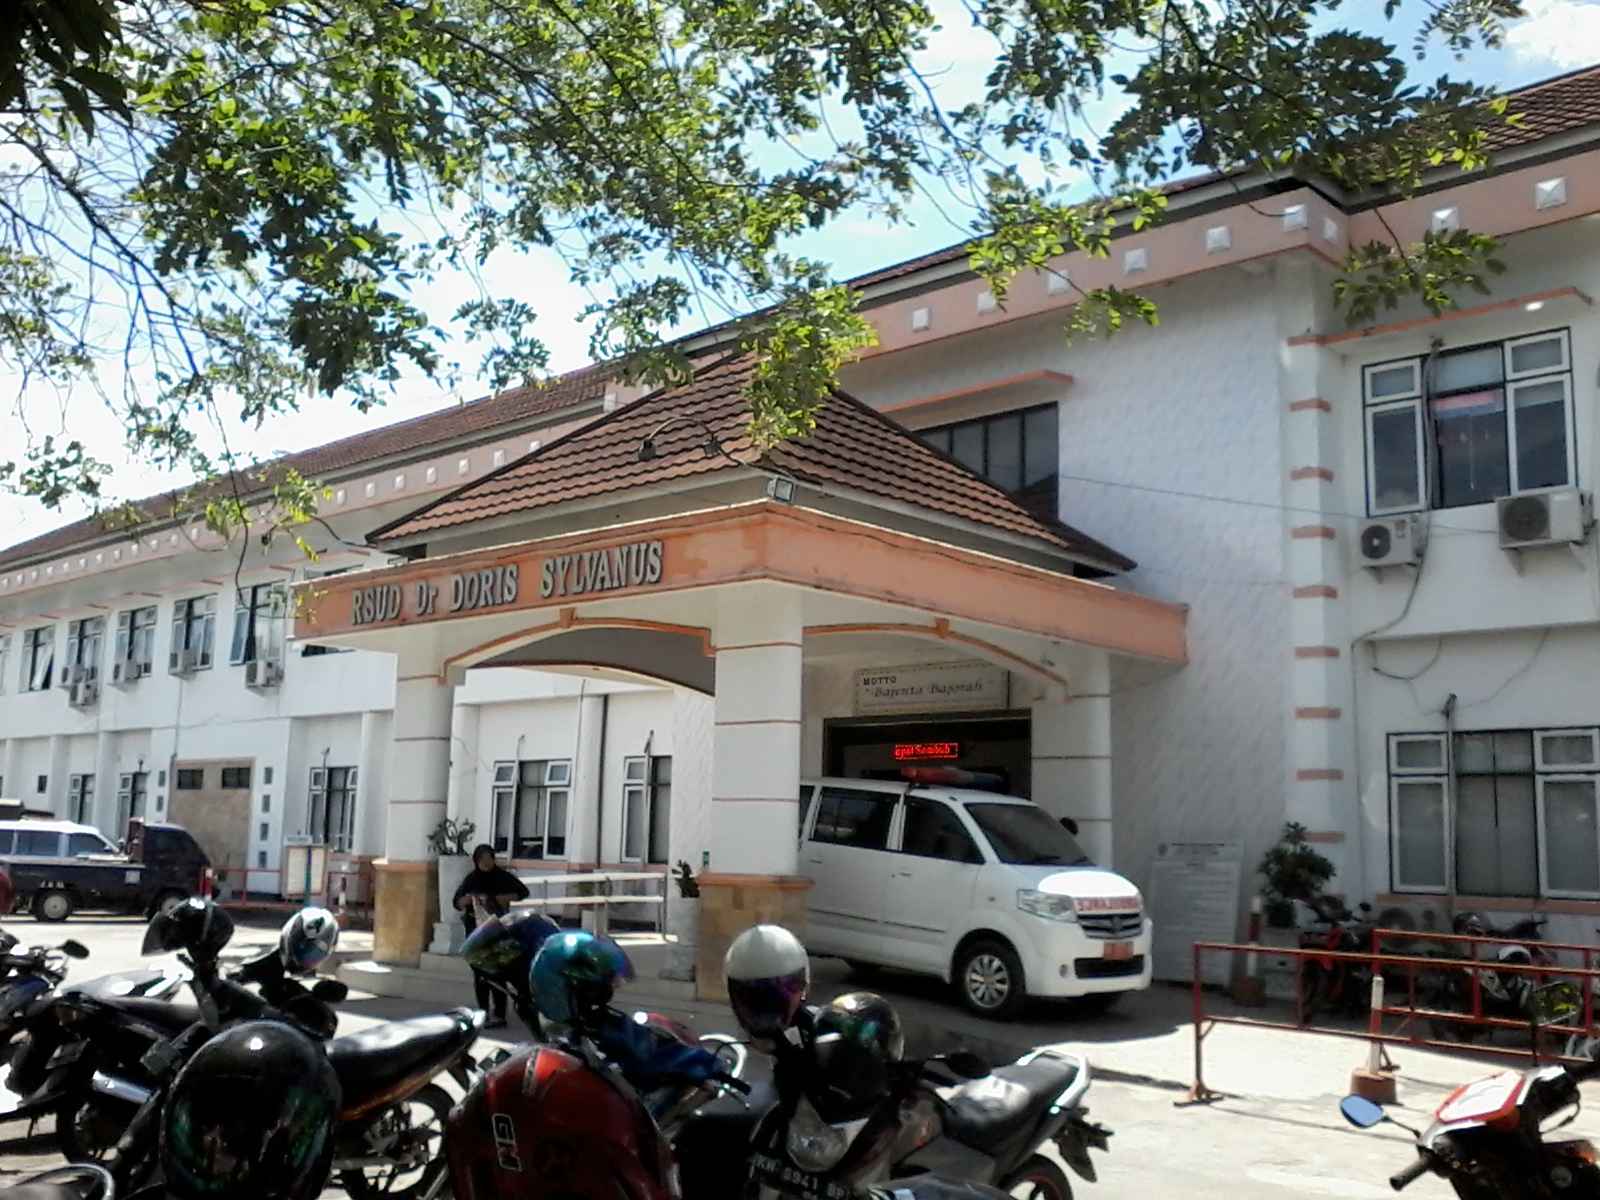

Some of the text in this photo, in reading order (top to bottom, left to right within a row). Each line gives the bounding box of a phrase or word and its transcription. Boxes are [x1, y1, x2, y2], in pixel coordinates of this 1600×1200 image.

[352, 541, 663, 625] RSUD Dr DORIS SYLVANUS
[863, 676, 897, 685] MOTTO
